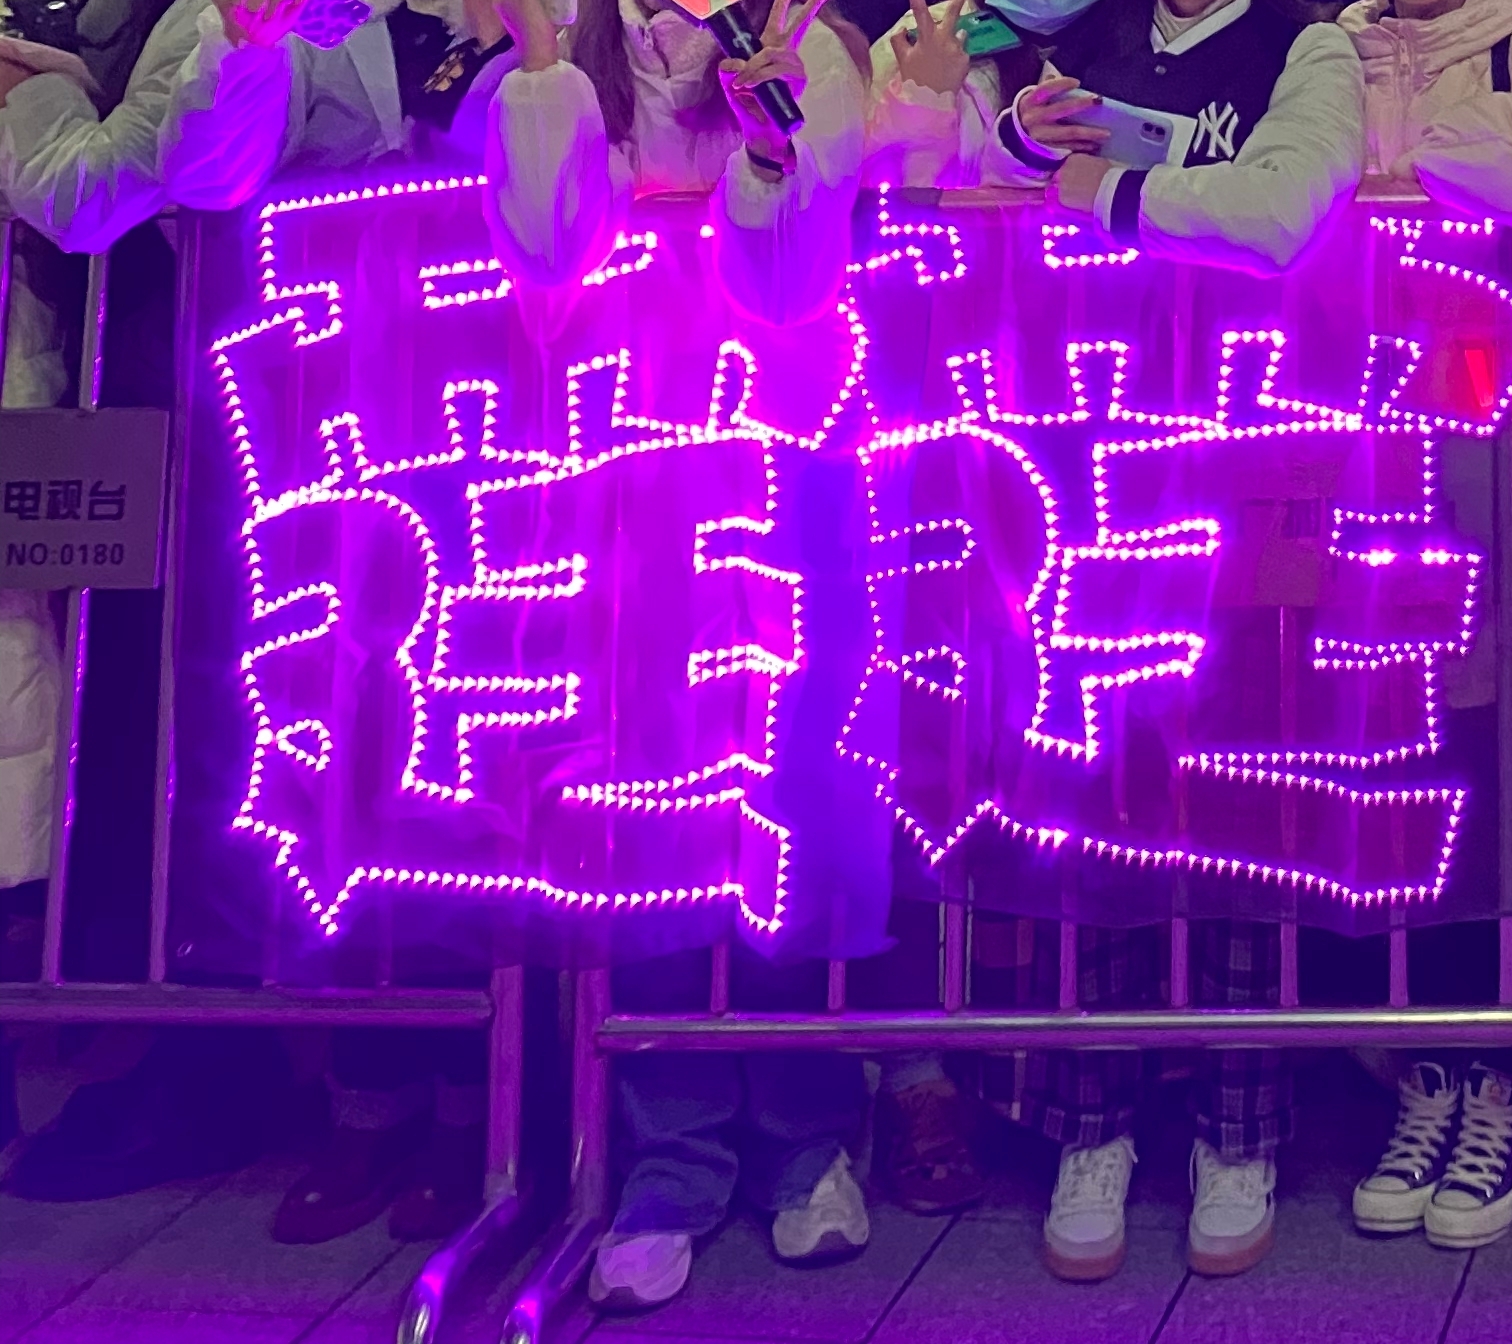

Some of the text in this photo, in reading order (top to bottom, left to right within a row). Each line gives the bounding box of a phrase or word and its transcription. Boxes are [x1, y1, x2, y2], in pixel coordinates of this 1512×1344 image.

[1193, 101, 1239, 158] NY
[3, 479, 127, 520] 电视台
[7, 542, 124, 565] NO:0180
